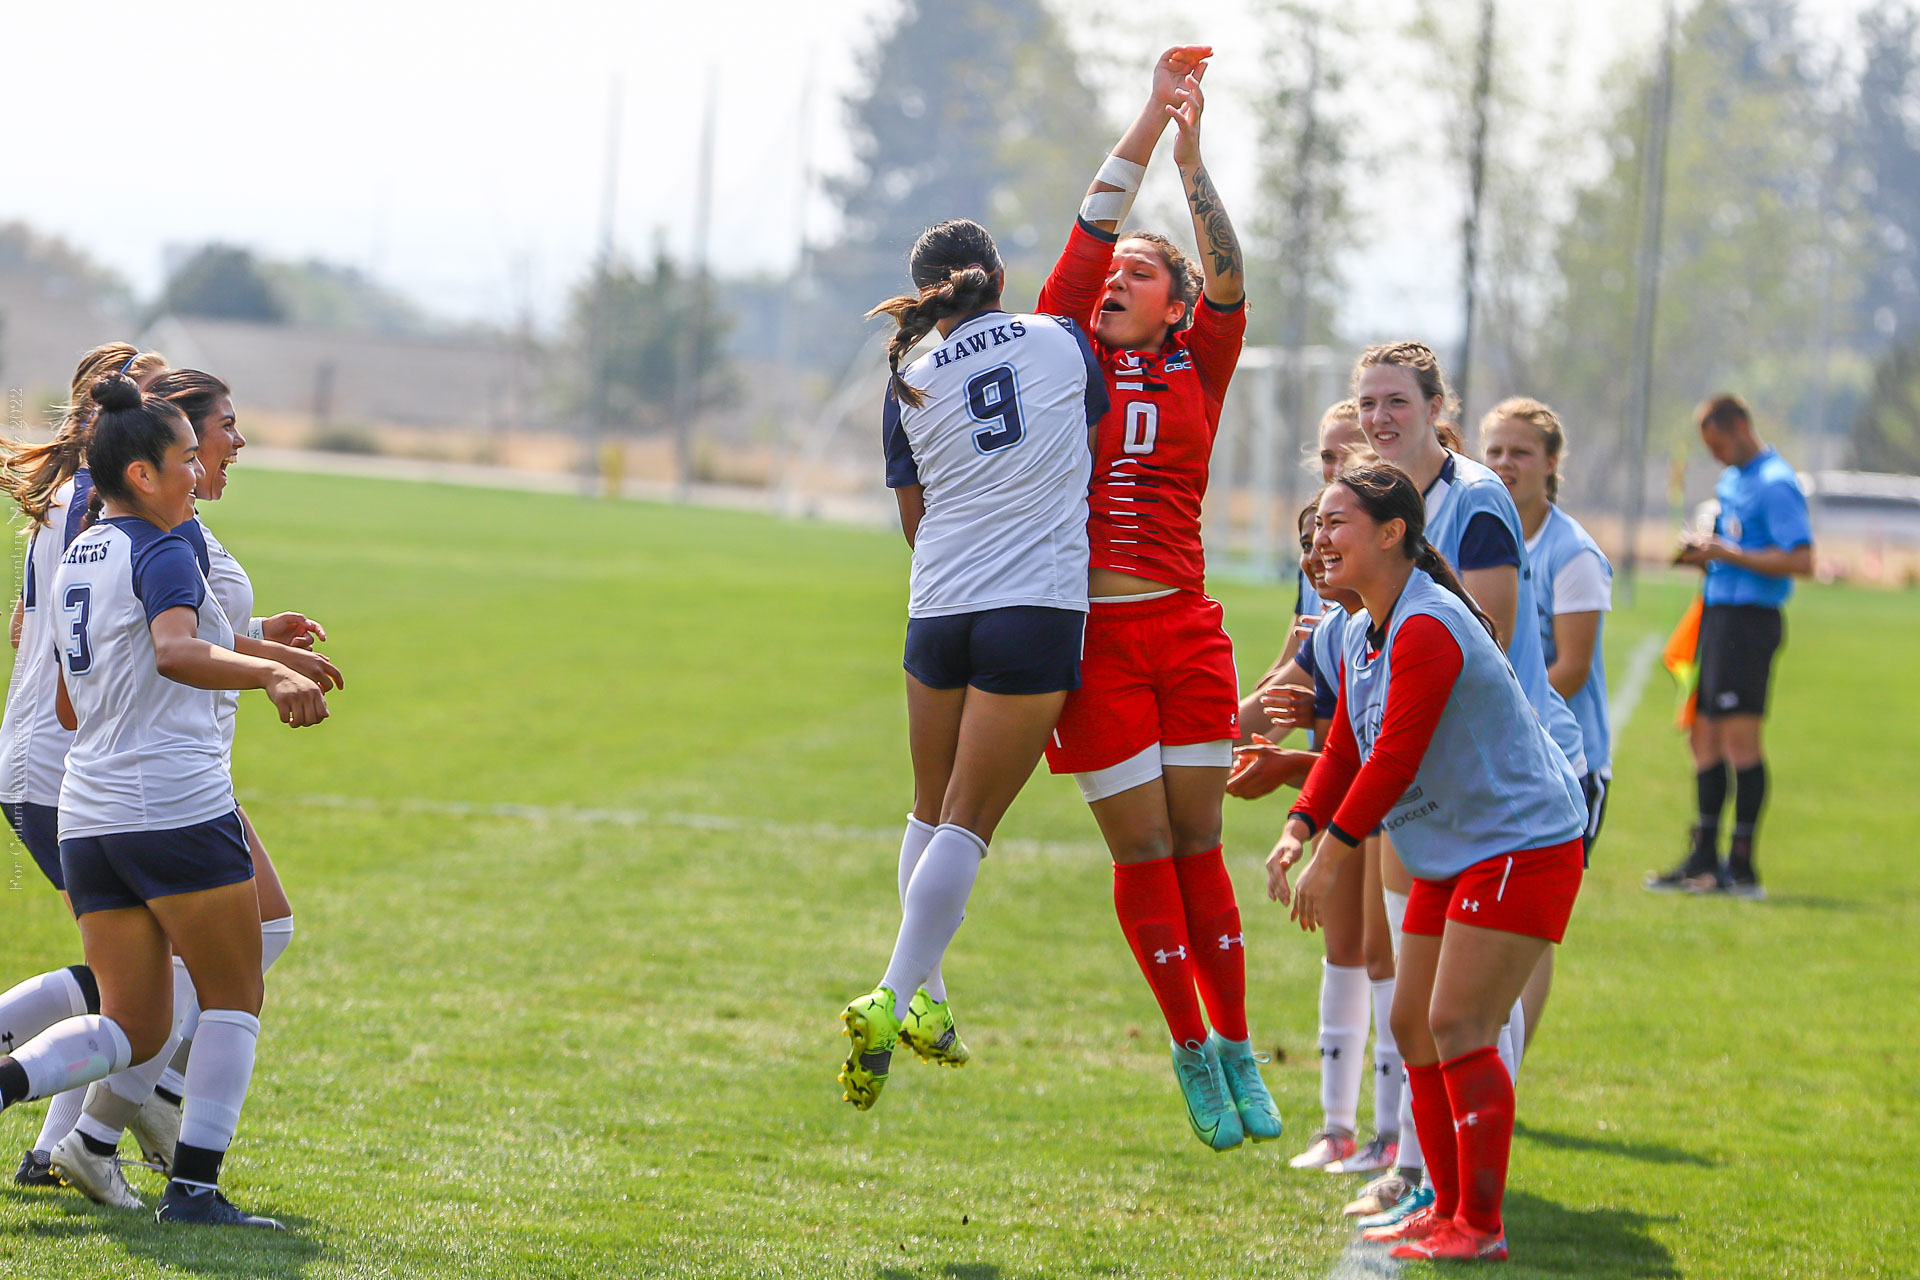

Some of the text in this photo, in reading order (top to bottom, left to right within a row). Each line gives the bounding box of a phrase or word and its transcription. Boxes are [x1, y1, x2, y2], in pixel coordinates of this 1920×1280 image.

[932, 320, 1027, 369] HAWKS
[1164, 360, 1193, 373] CBC
[963, 361, 1026, 456] 9
[1122, 400, 1159, 456] 0
[63, 583, 94, 676] 3
[1386, 800, 1440, 831] SOCCER
